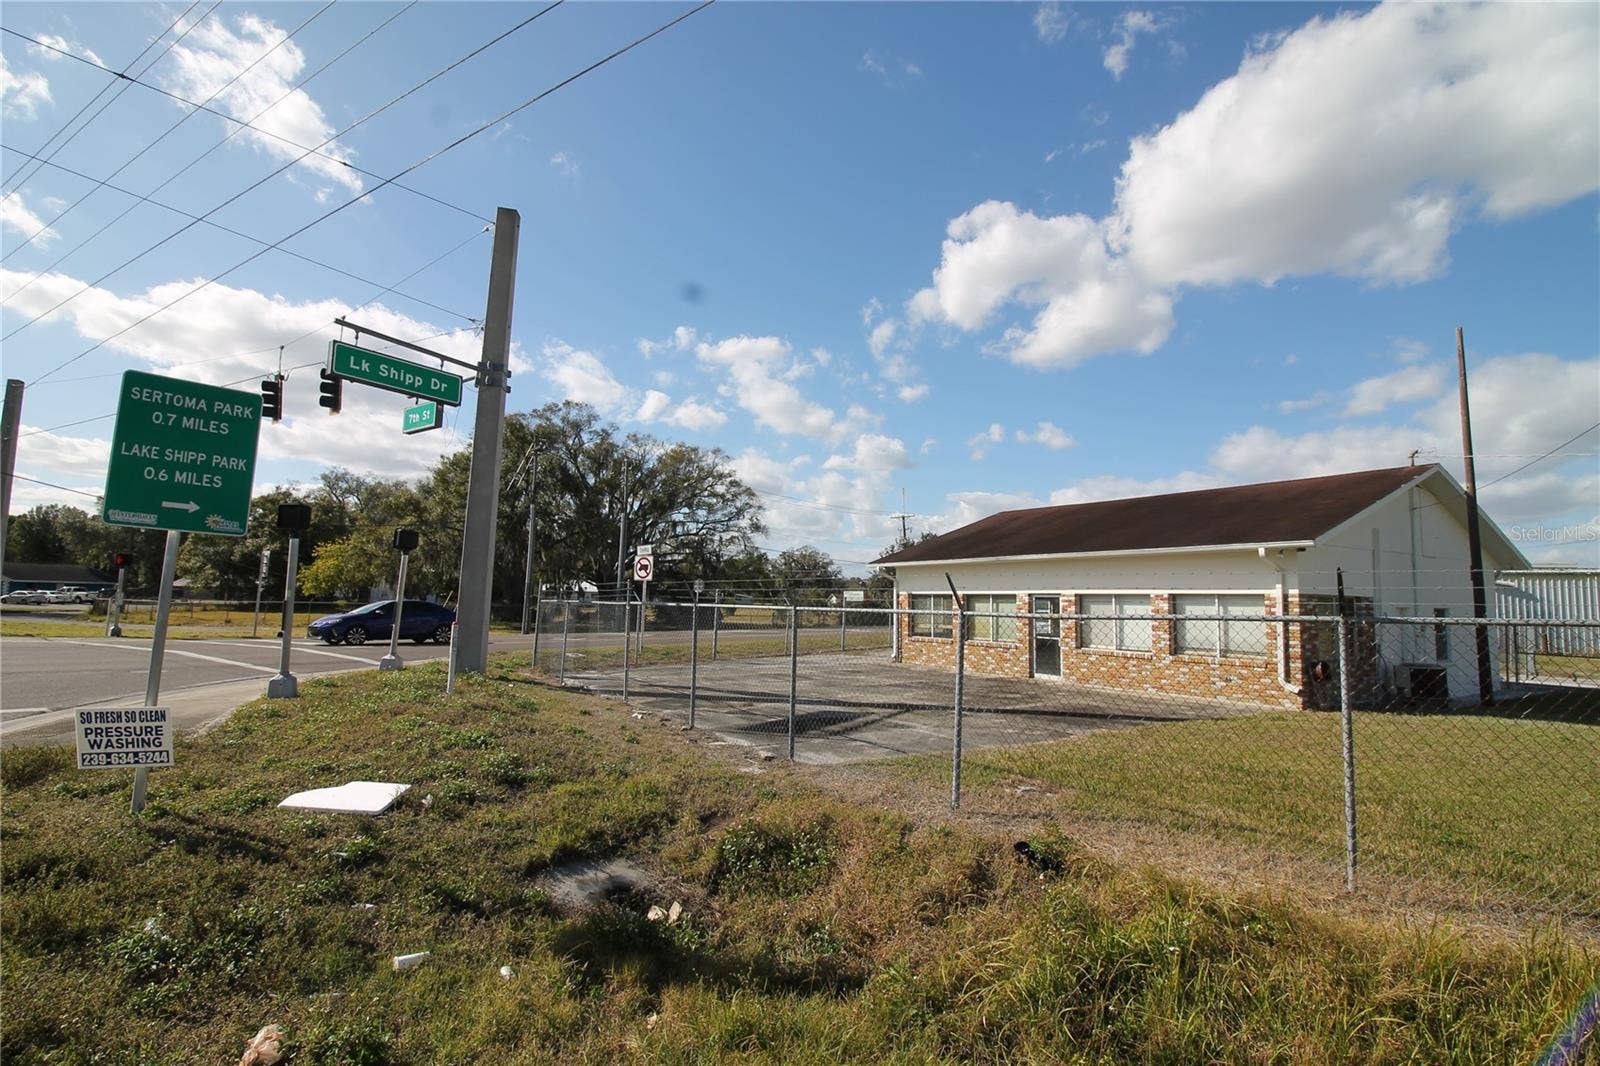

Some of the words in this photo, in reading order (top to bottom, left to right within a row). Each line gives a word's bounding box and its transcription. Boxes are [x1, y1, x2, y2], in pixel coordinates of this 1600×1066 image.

[350, 356, 370, 372] Lk
[378, 364, 423, 388] Shipp
[430, 378, 448, 392] Dr
[130, 387, 208, 412] SERTOMA
[214, 402, 254, 419] PARK
[152, 412, 177, 426] 0.7
[182, 416, 230, 435] MILES
[408, 414, 420, 422] 7th
[422, 410, 430, 420] St
[121, 442, 160, 459] LAKE
[164, 449, 206, 464] SHIPP
[212, 456, 247, 471] PARK
[144, 467, 168, 481] 0.6
[174, 470, 222, 488] MILES
[80, 712, 92, 724] SO
[94, 712, 122, 724] FRESH
[124, 711, 136, 722] SO
[138, 710, 166, 722] CLEAN
[84, 726, 164, 738] PRESSURE
[88, 737, 162, 750] WASHING
[83, 752, 168, 766] 239-634-5244
